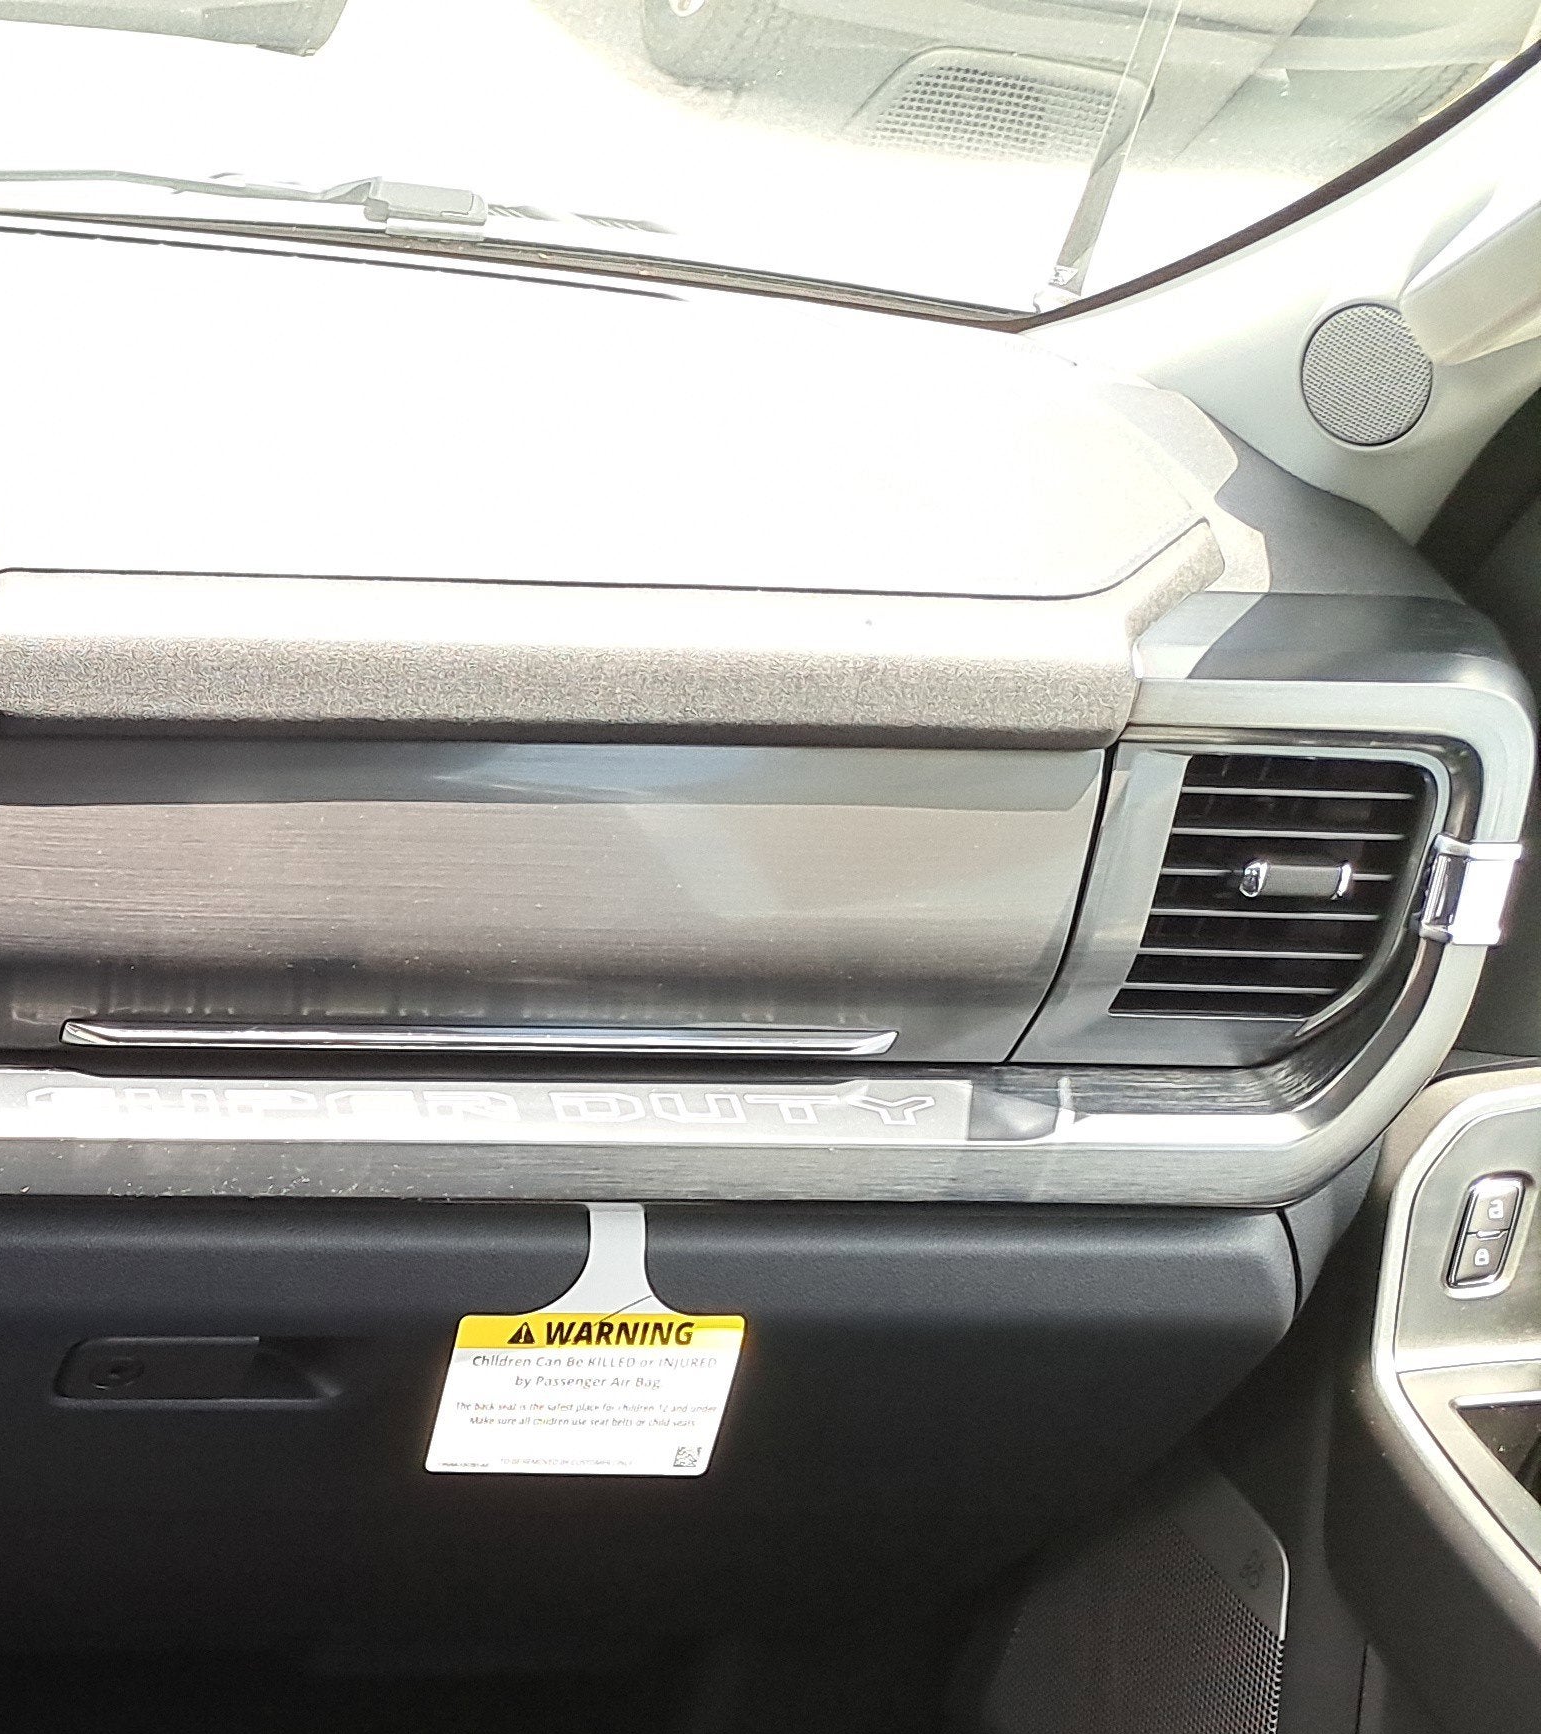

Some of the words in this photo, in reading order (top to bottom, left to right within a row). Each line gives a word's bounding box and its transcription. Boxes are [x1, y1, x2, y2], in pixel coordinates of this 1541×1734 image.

[548, 1091, 935, 1125] DUTY
[546, 1322, 695, 1346] WARNING
[472, 1355, 531, 1367] Children
[535, 1356, 561, 1367] Can
[567, 1356, 584, 1367] Be
[588, 1356, 636, 1368] KILLED
[640, 1359, 654, 1368] or
[658, 1357, 717, 1369] INJURED
[515, 1376, 532, 1389] by
[535, 1376, 606, 1390] Passenger
[610, 1376, 632, 1388] Air
[635, 1377, 661, 1390] Bag
